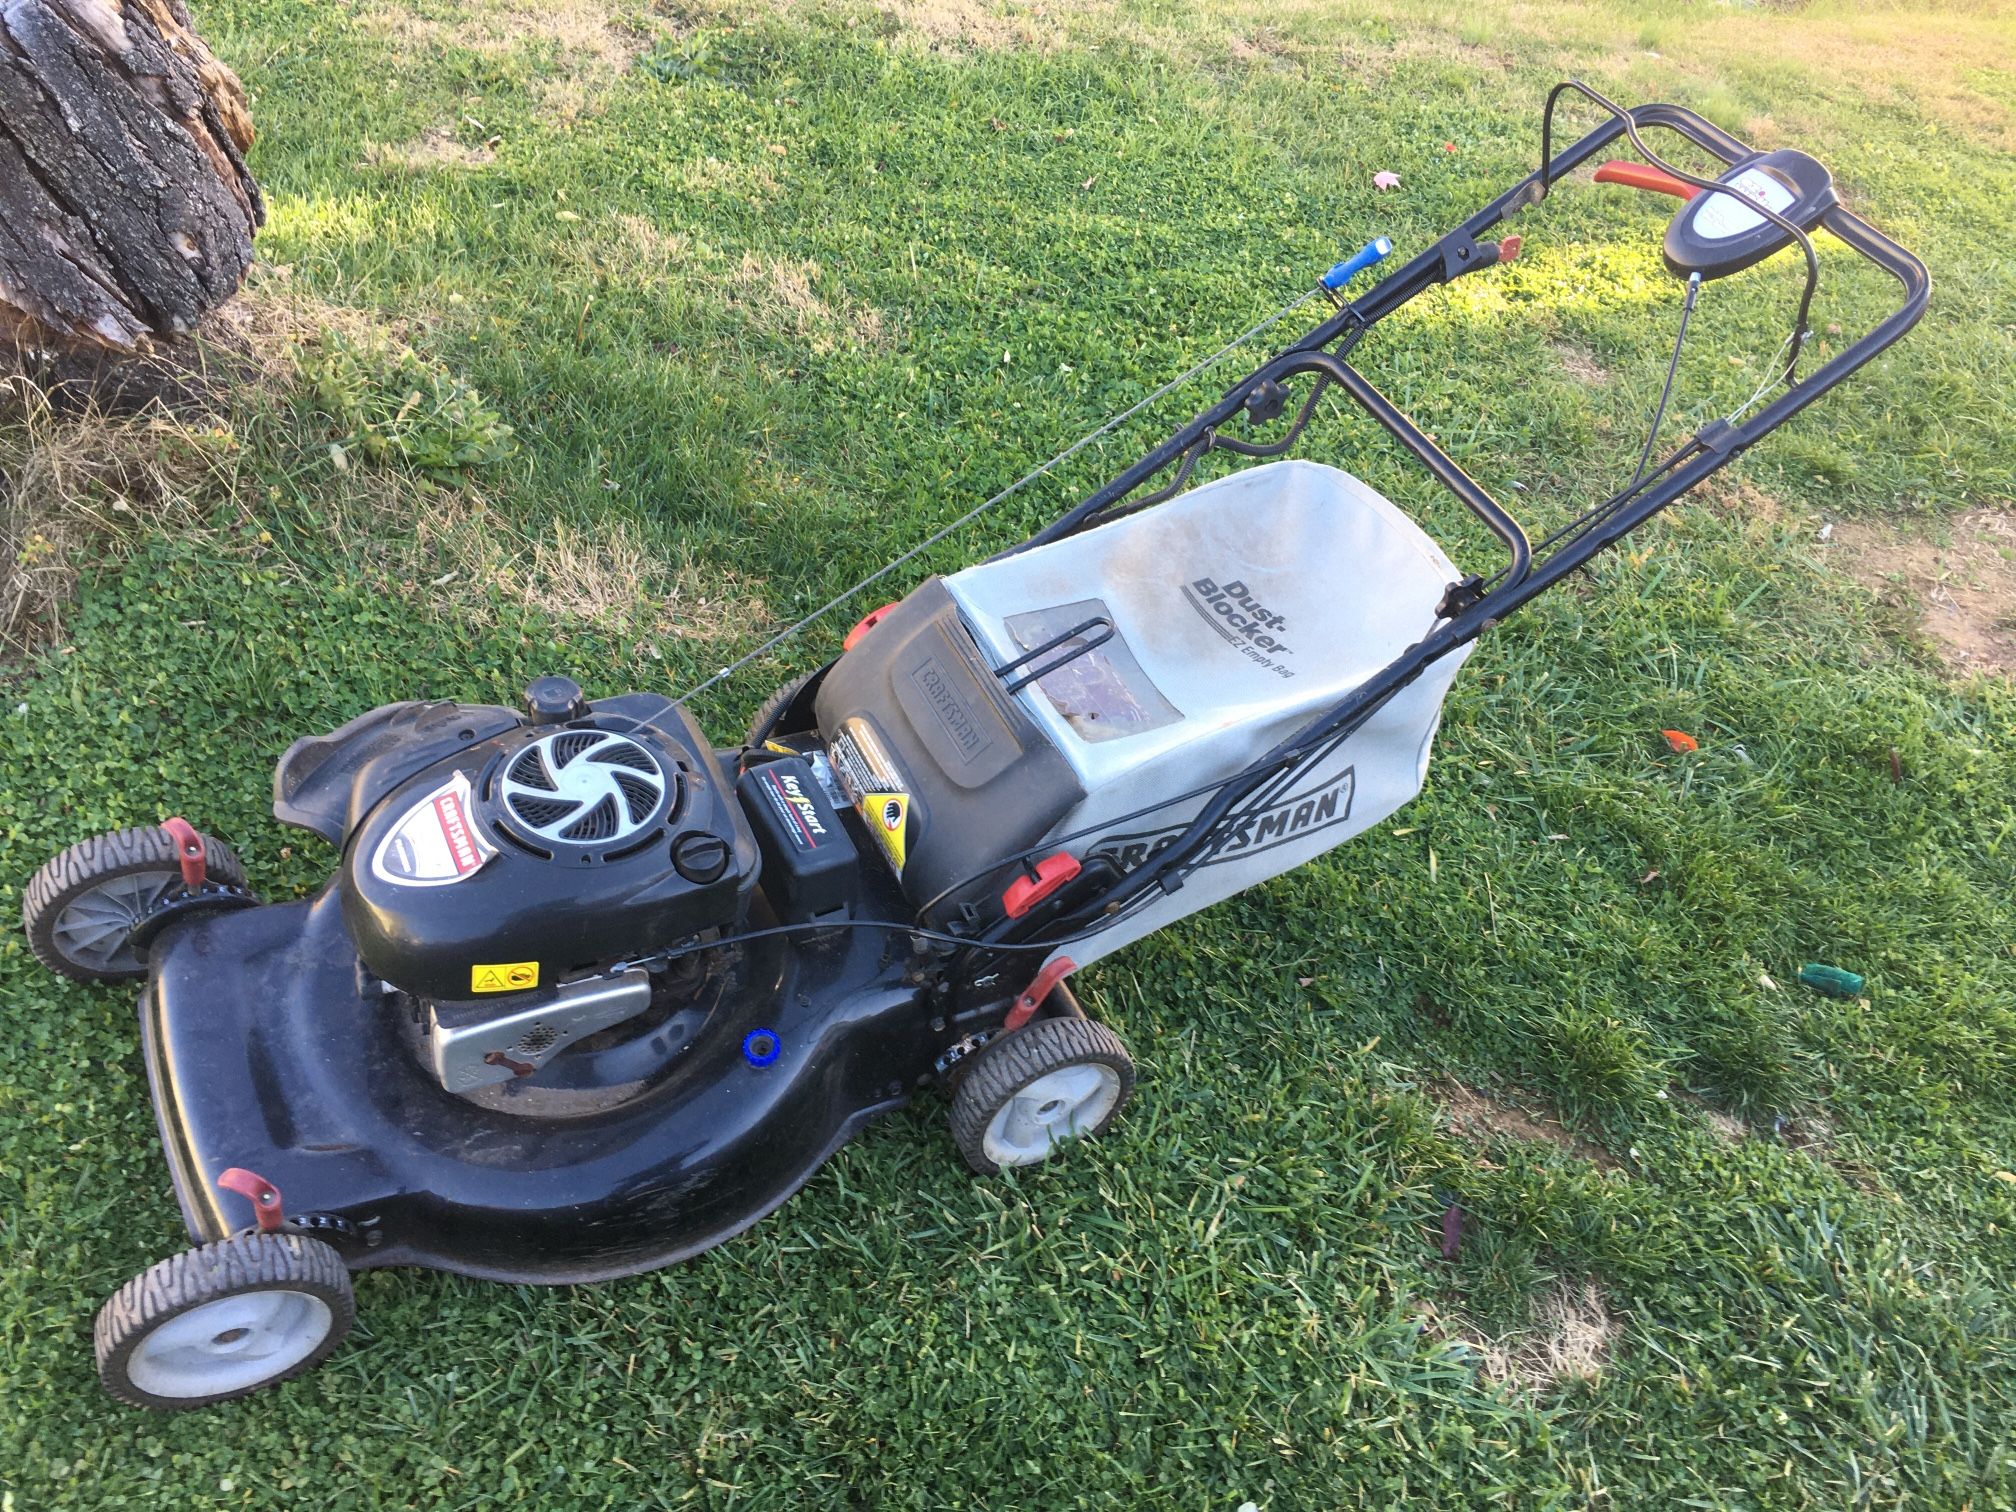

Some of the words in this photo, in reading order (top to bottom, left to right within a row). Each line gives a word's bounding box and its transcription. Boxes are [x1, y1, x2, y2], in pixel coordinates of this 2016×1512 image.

[1222, 580, 1286, 632] Dust-
[1229, 636, 1247, 648] EZ
[1241, 646, 1274, 668] Empty
[1272, 665, 1295, 678] Bag
[922, 667, 980, 750] CRAFTSMAN
[439, 797, 475, 868] CRAFTSMAN
[781, 775, 804, 797] Key
[797, 803, 827, 834] Start
